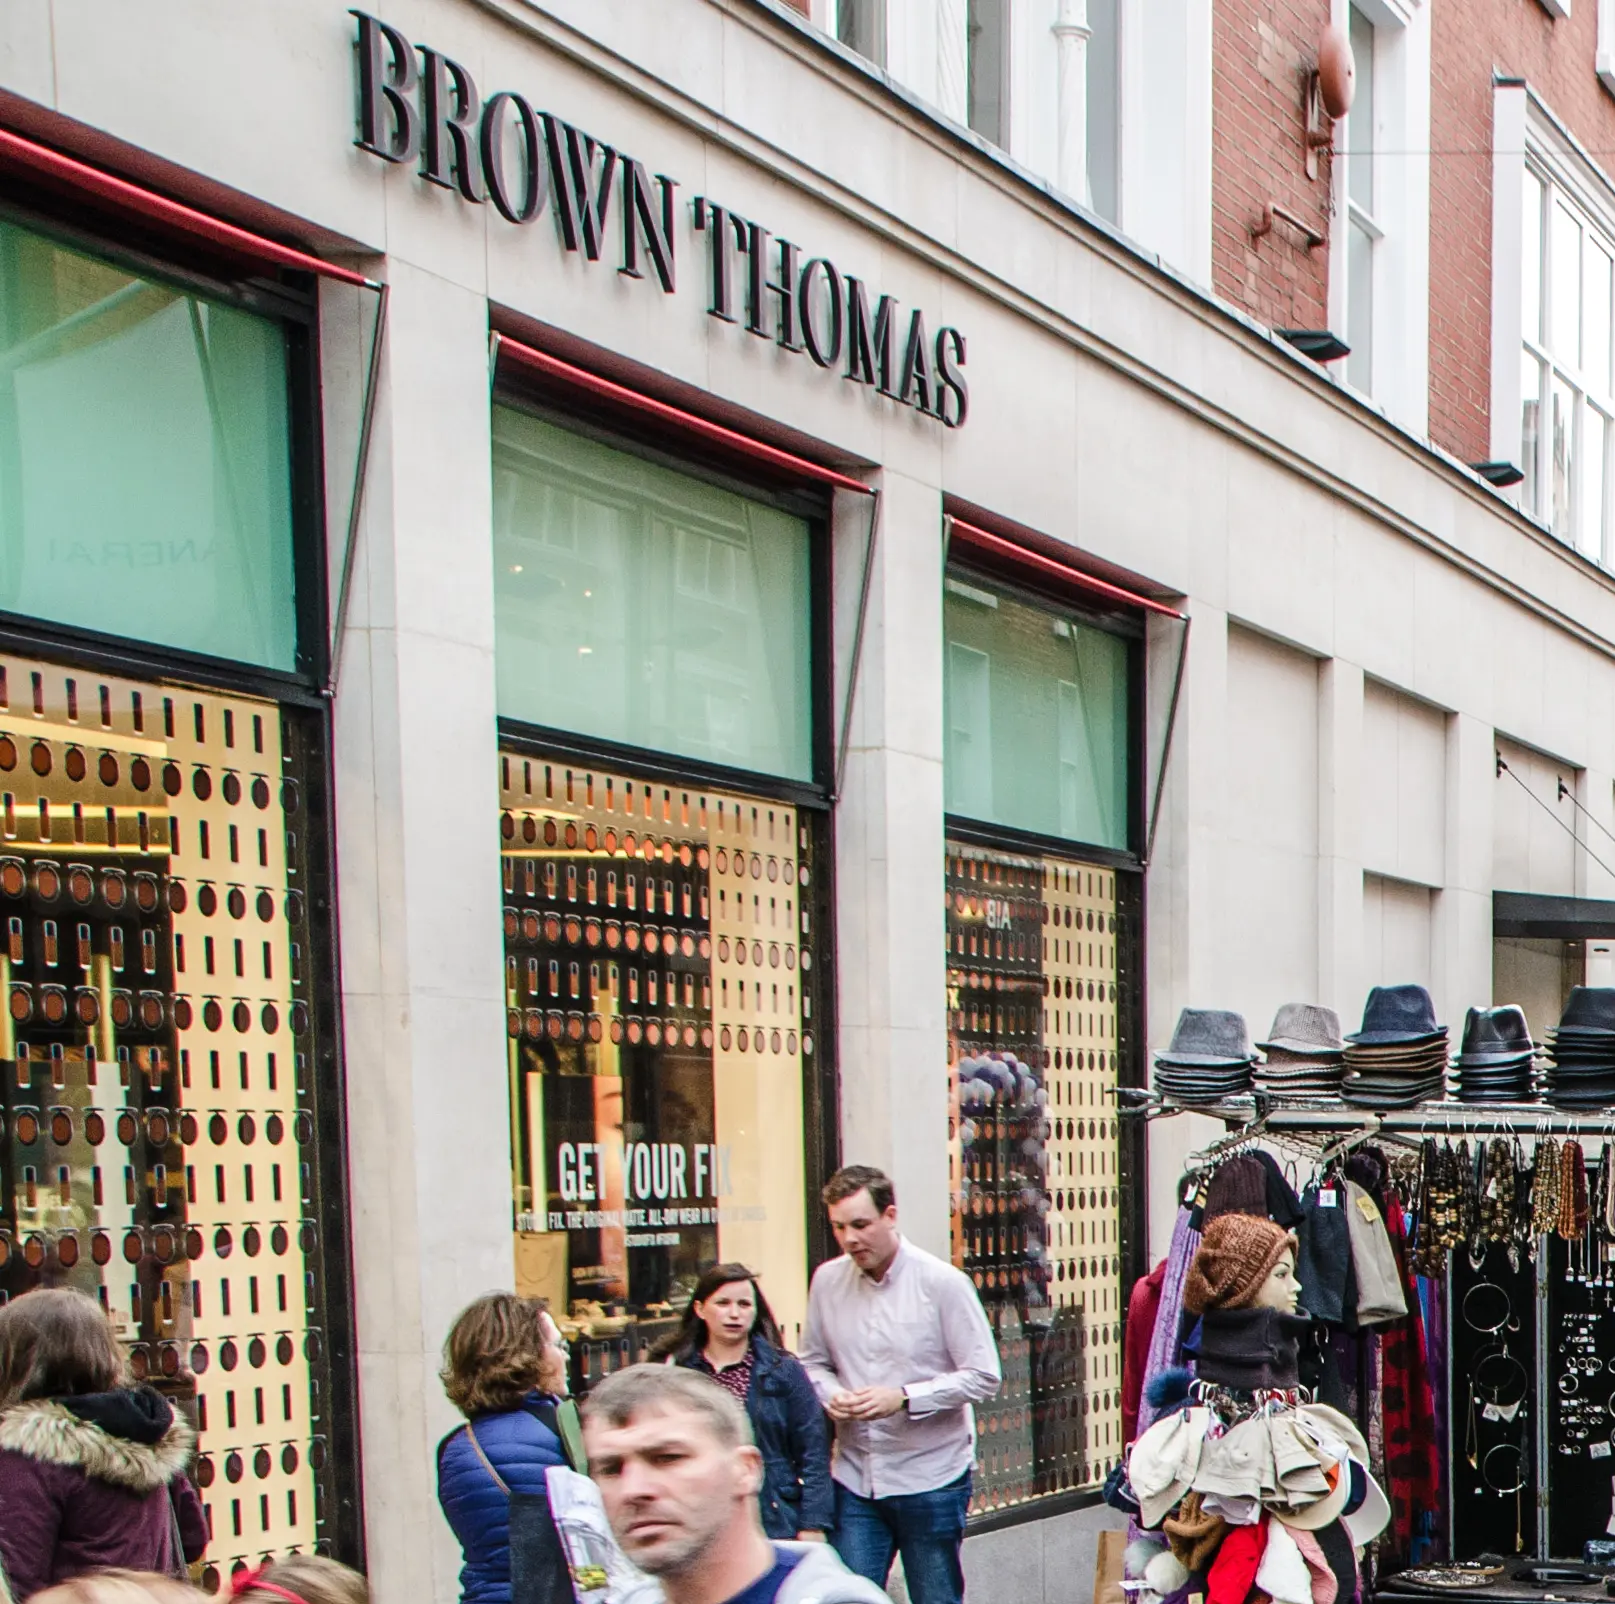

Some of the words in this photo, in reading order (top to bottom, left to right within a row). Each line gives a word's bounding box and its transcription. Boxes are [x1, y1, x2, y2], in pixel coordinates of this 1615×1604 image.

[349, 9, 680, 294] BROWN
[693, 196, 970, 430] THOMAS
[558, 1142, 607, 1201] GET
[617, 1142, 688, 1200] YOUR
[693, 1142, 733, 1199] FIX
